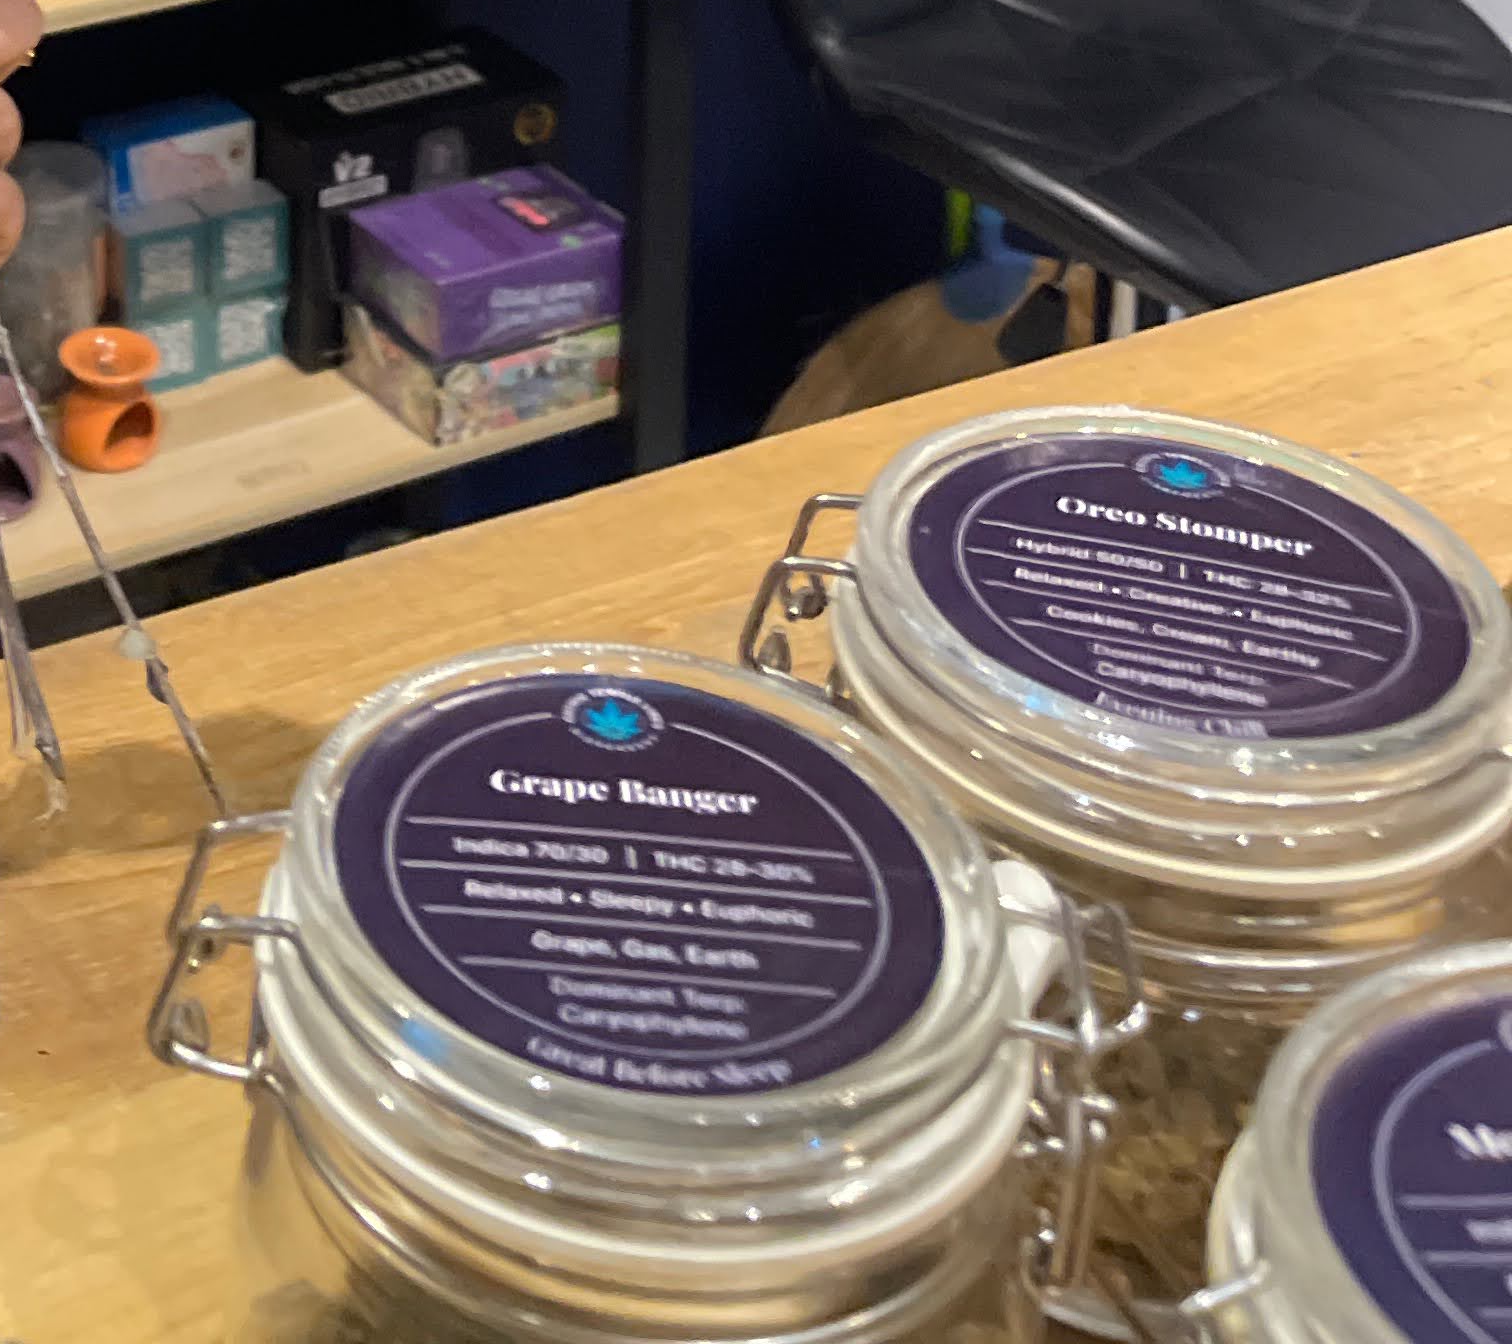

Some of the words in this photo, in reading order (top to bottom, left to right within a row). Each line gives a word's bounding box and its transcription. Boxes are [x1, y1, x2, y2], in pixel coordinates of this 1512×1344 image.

[1056, 495, 1147, 528] Oreo
[1155, 510, 1314, 558] Stomper
[489, 767, 609, 804] Grape
[619, 777, 759, 814] Banger
[650, 850, 707, 875] THC
[589, 888, 675, 918] Sleepy
